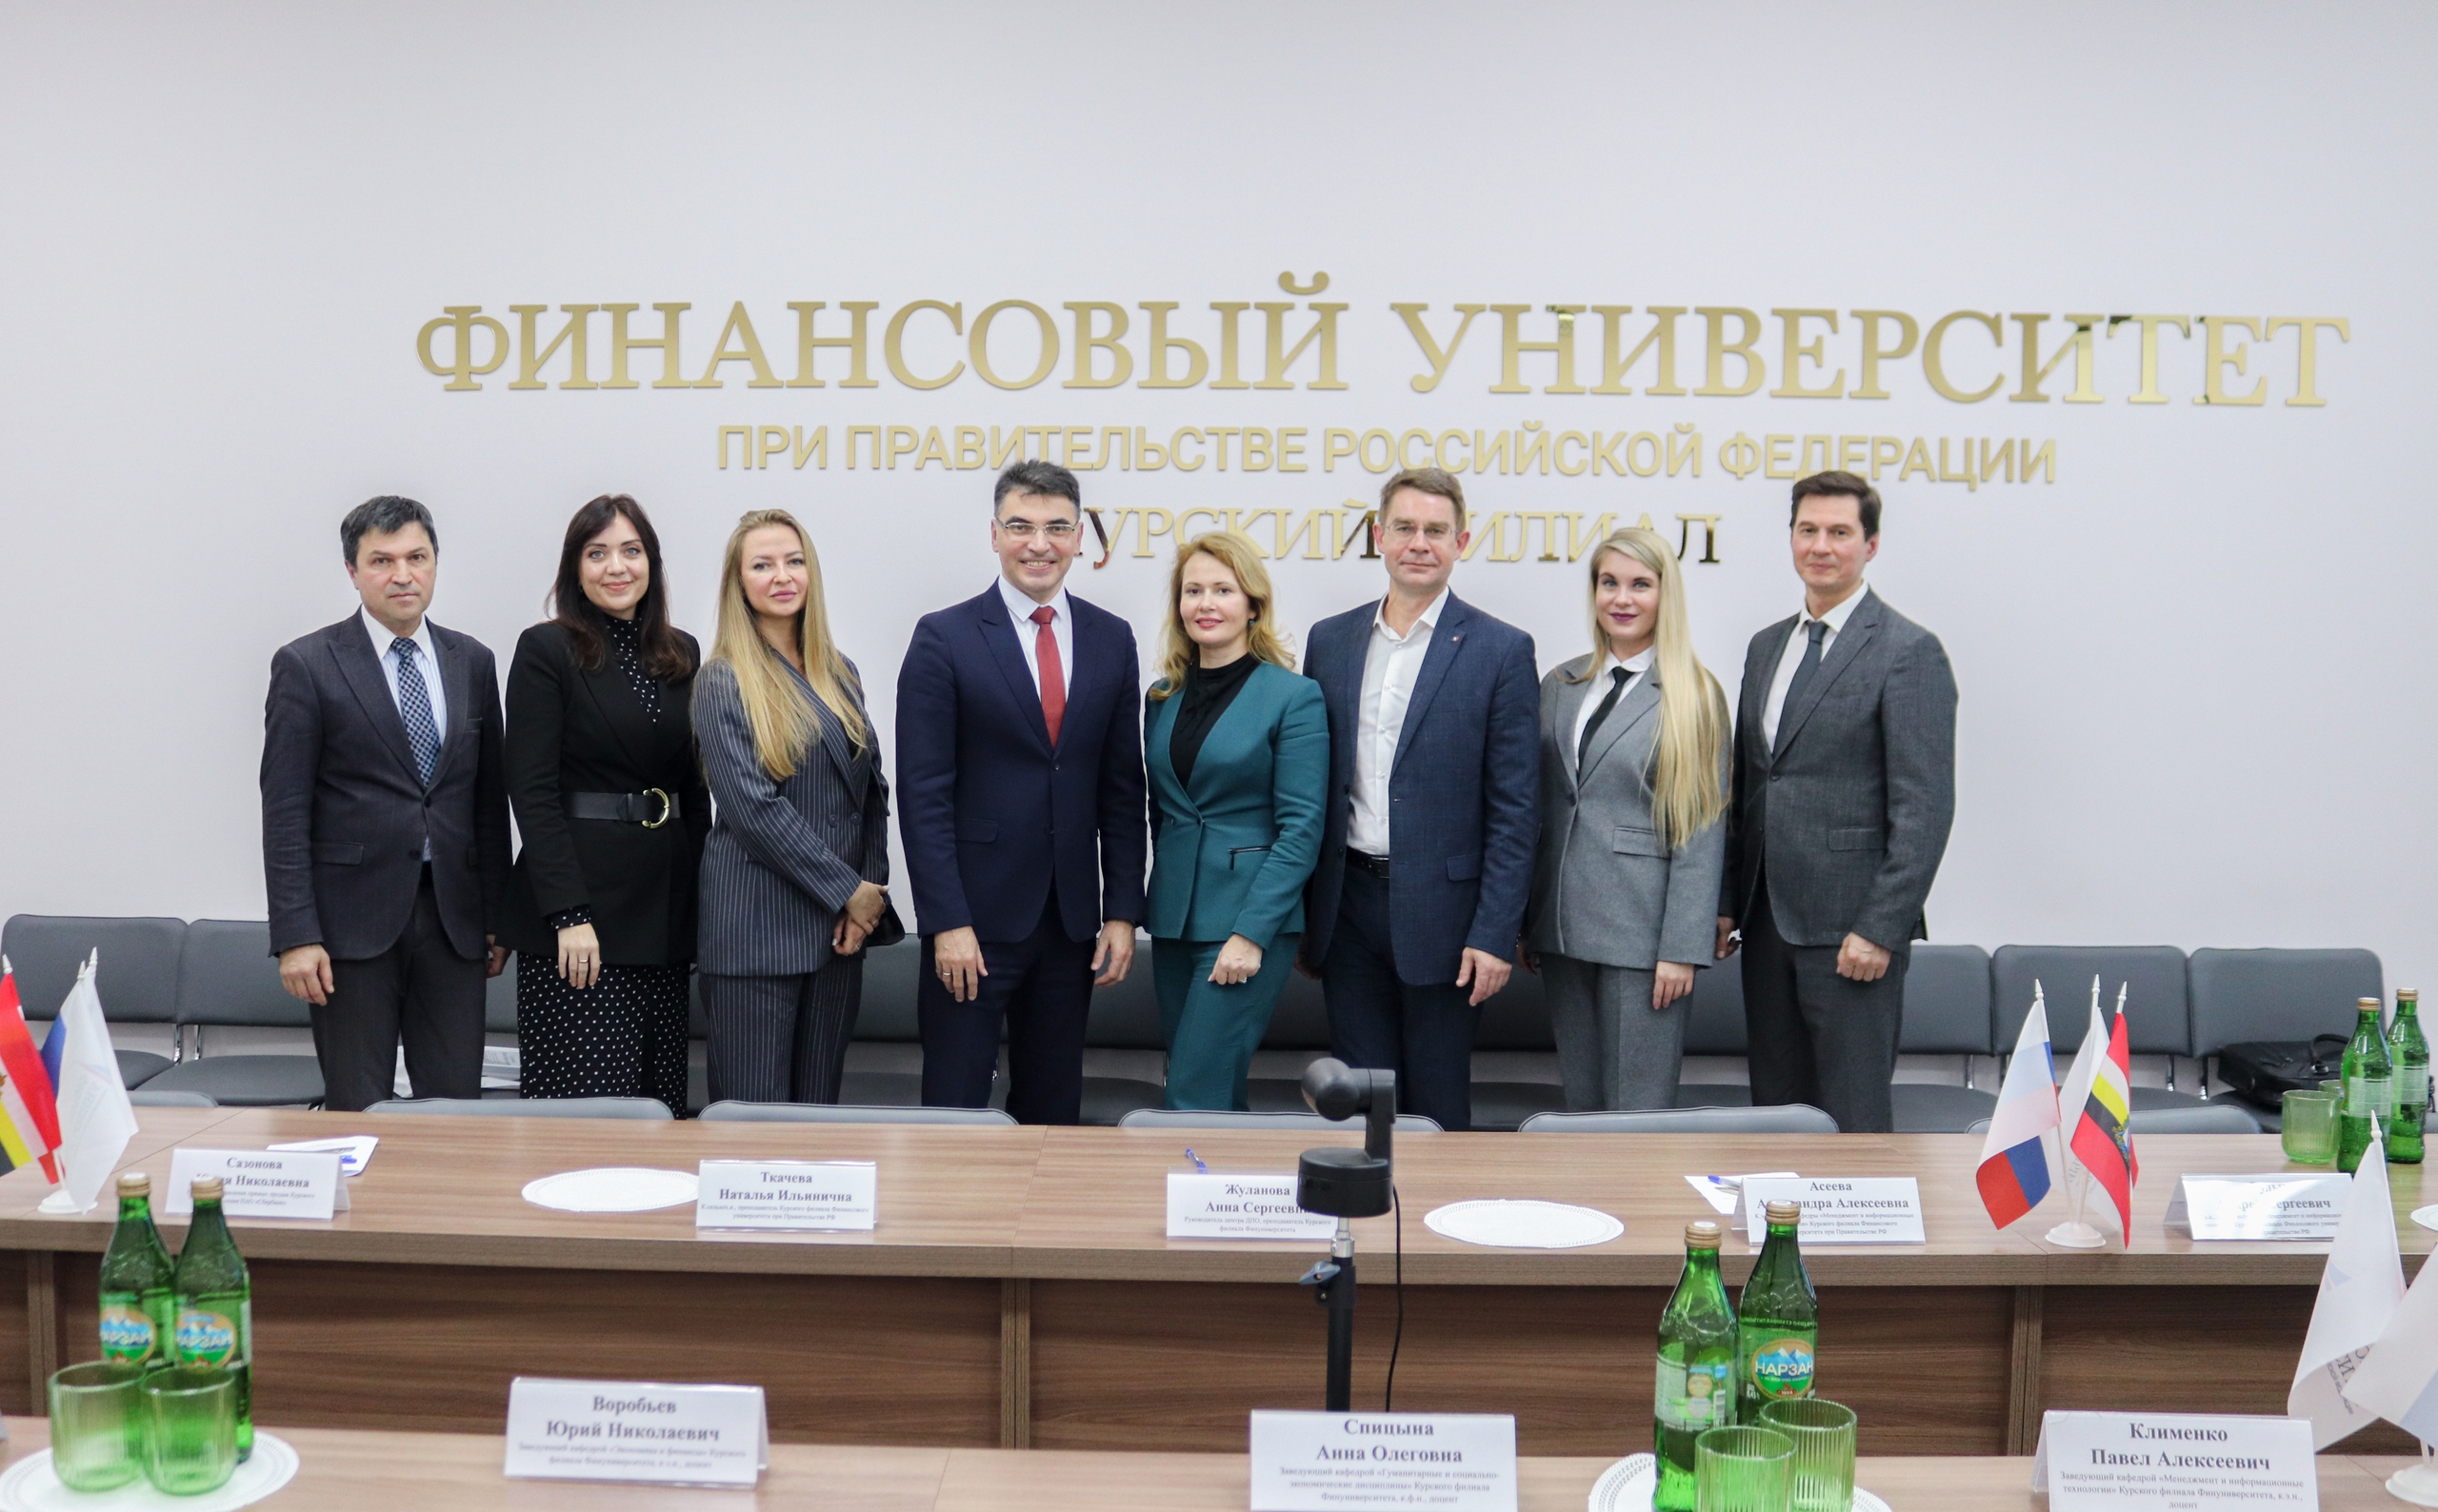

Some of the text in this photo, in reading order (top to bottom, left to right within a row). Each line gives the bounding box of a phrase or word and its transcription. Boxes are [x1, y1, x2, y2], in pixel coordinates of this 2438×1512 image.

[415, 270, 2350, 407] ФИНАНСОВЫЙ УНИВЕРСИТЕТ
[718, 420, 2057, 491] ПРИ ПРАВИТЕЛЬСТВЕ РОССИЙСКОЙ ФЕДЕРАЦИИ
[1078, 498, 1722, 568] УРСКИЙ ИЛИЛ
[227, 1157, 283, 1170] Сазонова
[237, 1175, 310, 1188] Николаевна
[760, 1171, 812, 1184] Ткачева
[1225, 1184, 1290, 1198] Жуланова
[1809, 1181, 1852, 1191] Асеева
[719, 1189, 852, 1203] Наталья Ильинична
[1836, 1198, 1908, 1208] Алексеевна
[1205, 1202, 1310, 1216] Анна Сергеевн
[2272, 1200, 2331, 1211] ергеевич
[1755, 1360, 1814, 1377] НАРЗАН
[592, 1396, 677, 1417] Воробьев
[546, 1420, 720, 1442] Юрий Николаевич
[1344, 1419, 1434, 1437] Спицына
[2129, 1422, 2228, 1442] Клименко
[1316, 1444, 1463, 1463] Анна Олеговна
[2090, 1448, 2271, 1470] Павел Алексеевич
[1279, 1466, 1333, 1478] Заведующий
[1335, 1467, 1375, 1480] кафедрой
[2060, 1470, 2114, 1483] Заведующий
[2116, 1473, 2157, 1484] кафедрой
[2158, 1474, 2219, 1485] «Менеджмент
[2228, 1477, 2304, 1488] информационные
[1289, 1481, 1353, 1489] экономические
[1414, 1482, 1453, 1492] Курского
[1454, 1482, 1490, 1493] филиала
[2063, 1484, 2117, 1495] технологии»
[2119, 1485, 2158, 1498] Курского
[2159, 1485, 2195, 1498] филиала
[2197, 1487, 2276, 1502] Финуниверситета,
[1429, 1495, 1458, 1504] доцент
[2168, 1501, 2198, 1510] доцент
